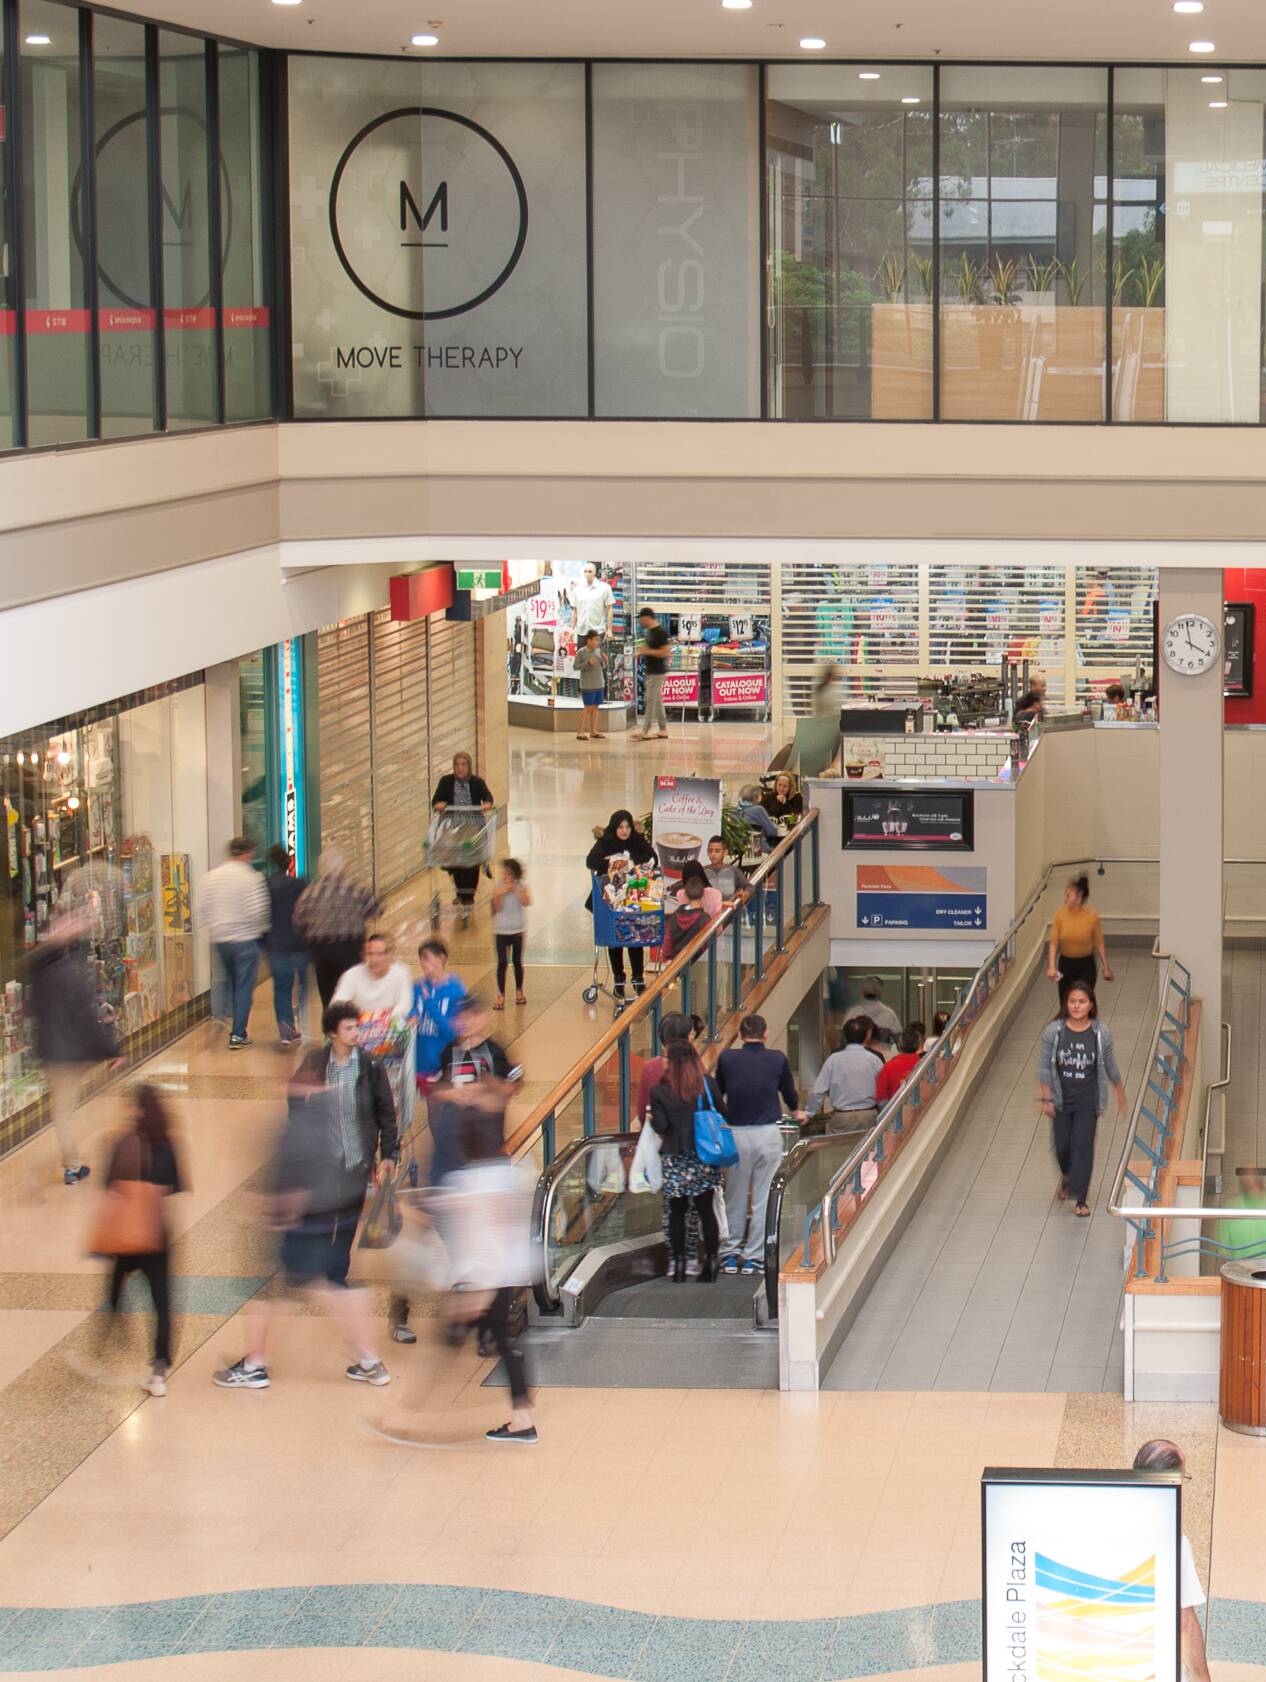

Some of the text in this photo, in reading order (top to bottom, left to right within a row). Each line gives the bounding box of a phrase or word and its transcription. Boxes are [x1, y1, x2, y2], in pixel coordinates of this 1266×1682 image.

[400, 180, 449, 232] M
[336, 347, 524, 370] MOVE THERAPY
[672, 686, 694, 695] NOW
[715, 678, 764, 690] CATALOGUE
[718, 686, 761, 697] OUT NOW
[672, 791, 694, 806] Coffee
[658, 803, 676, 814] Cake
[1006, 1541, 1026, 1602] Plaza
